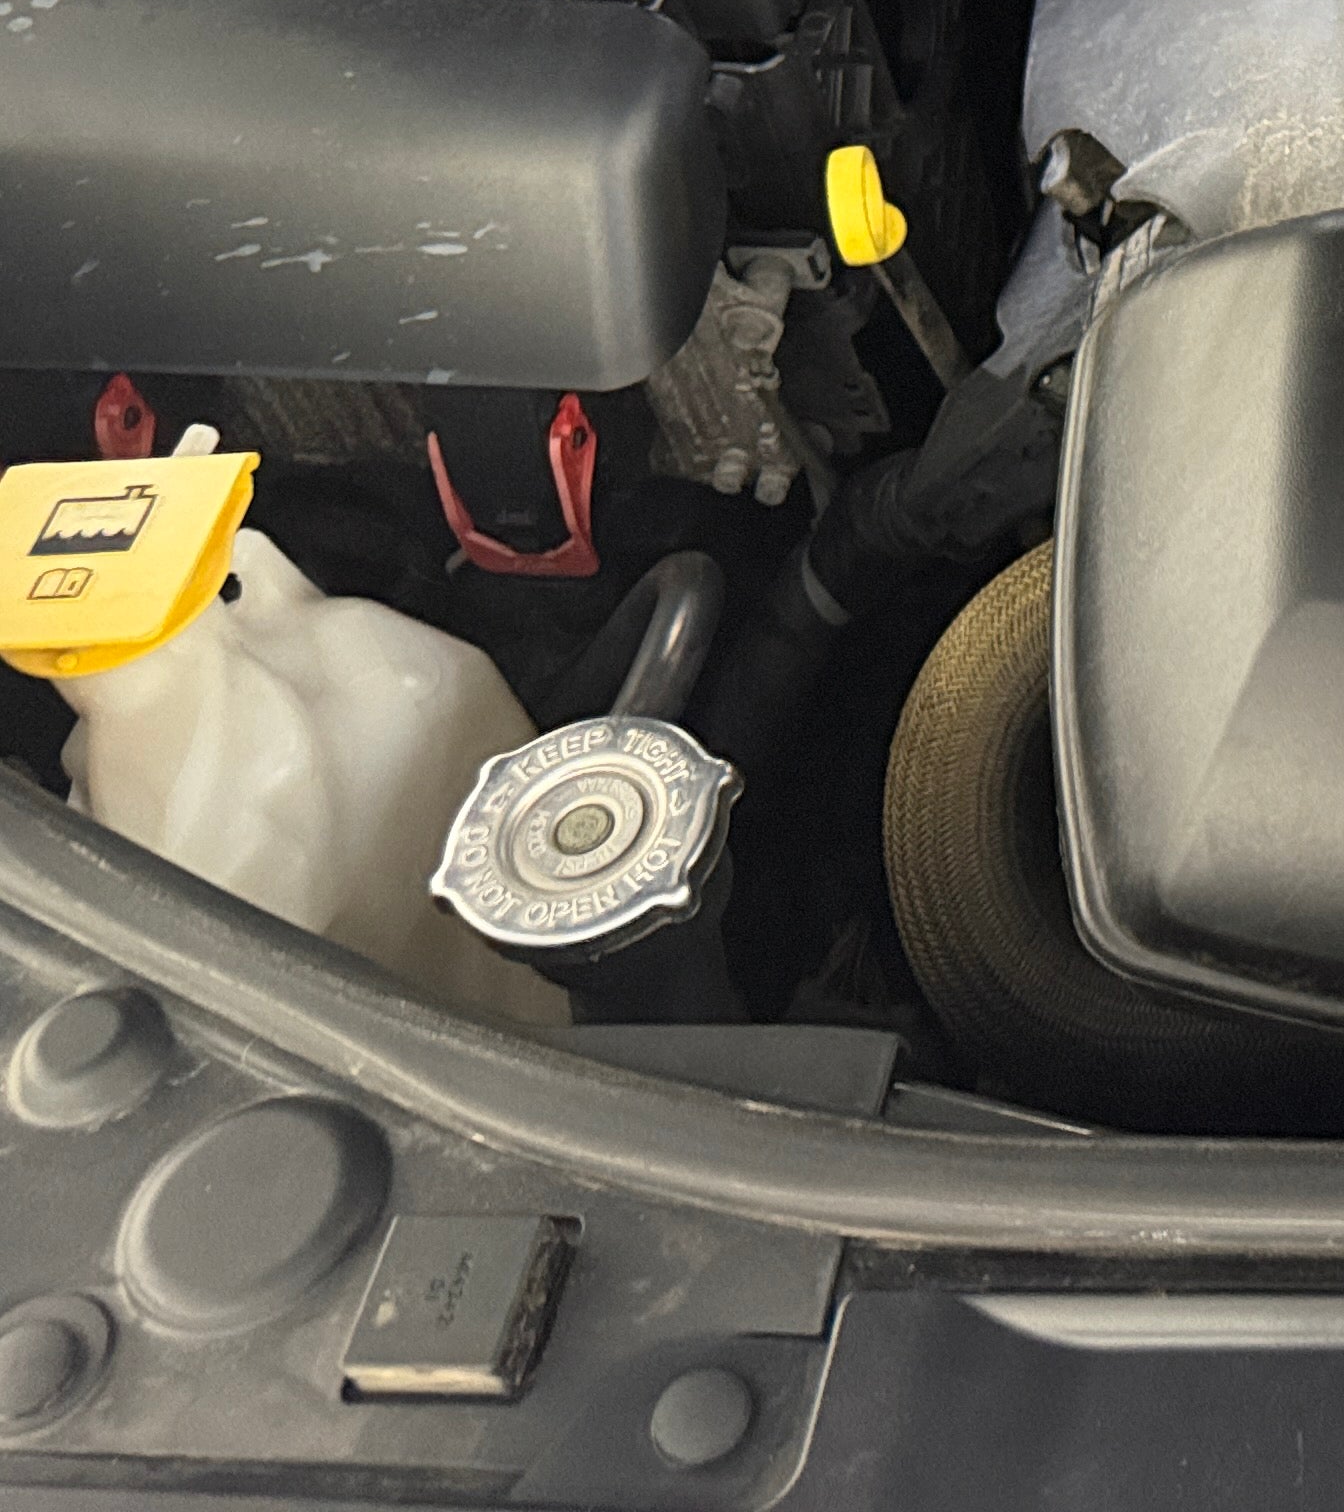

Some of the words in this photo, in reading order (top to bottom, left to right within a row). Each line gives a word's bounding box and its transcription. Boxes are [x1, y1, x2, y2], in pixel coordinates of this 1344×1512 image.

[512, 723, 615, 781] KEEP
[622, 727, 693, 785] TIGHT
[459, 825, 490, 868] DO
[620, 837, 682, 893] HOT
[465, 869, 521, 920] NOT
[522, 885, 622, 929] OPEN
